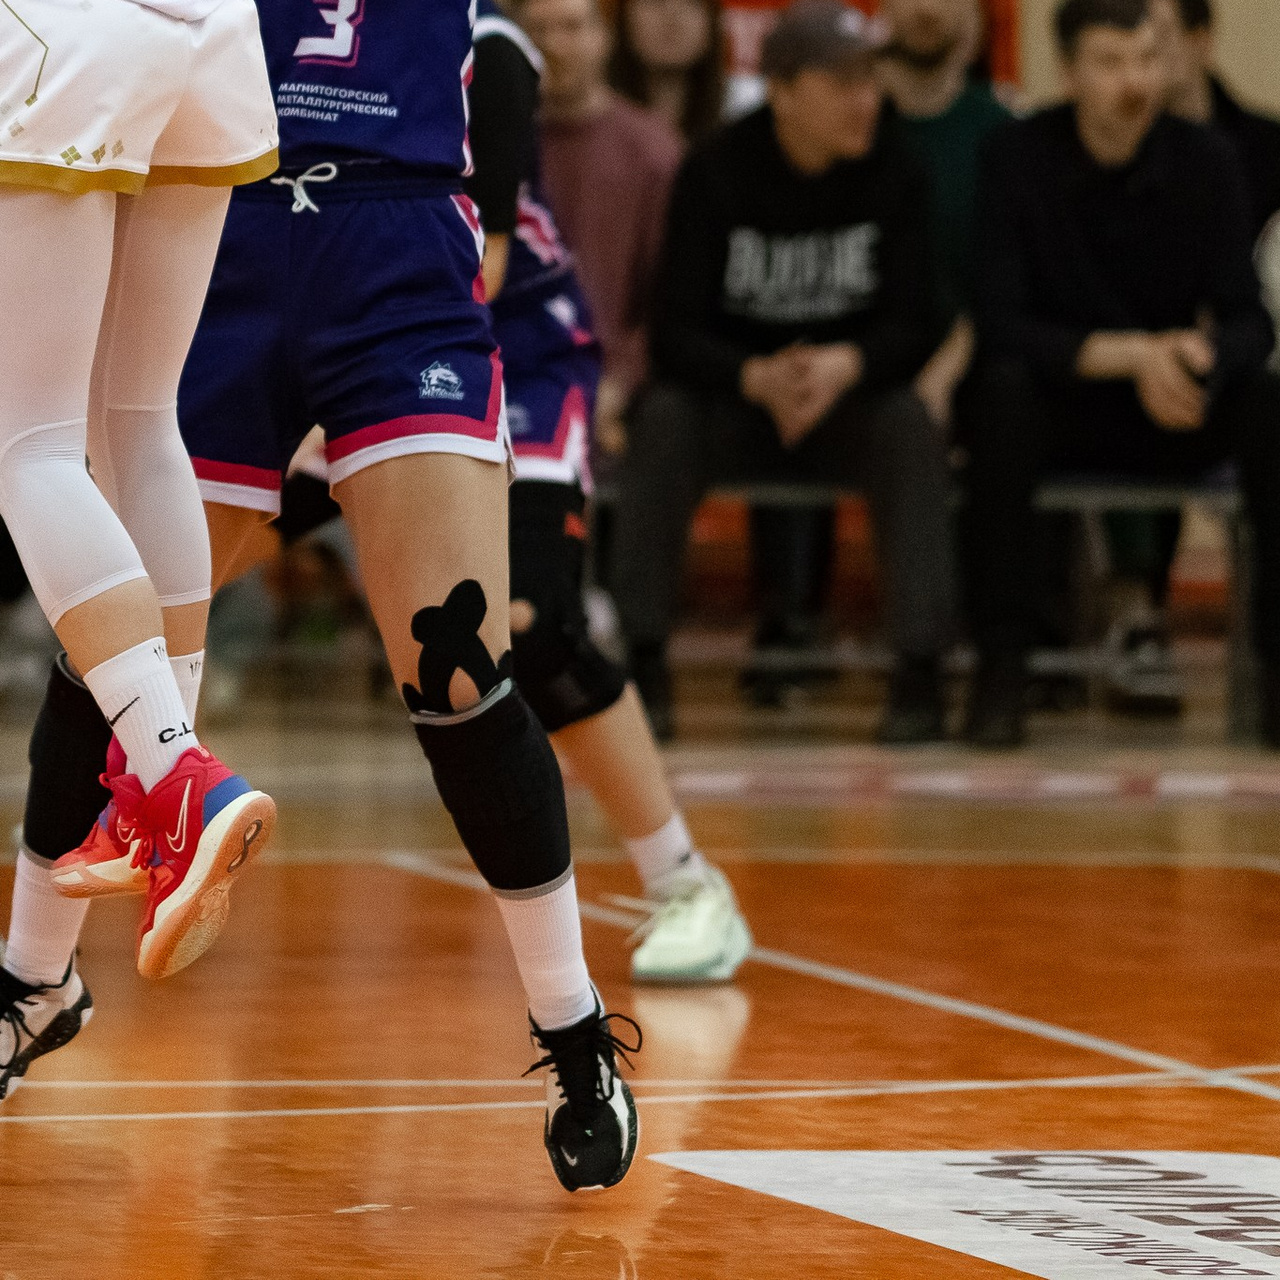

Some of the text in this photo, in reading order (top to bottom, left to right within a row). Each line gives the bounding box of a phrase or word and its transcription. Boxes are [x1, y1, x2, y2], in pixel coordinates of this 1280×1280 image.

[279, 83, 388, 103] МАГНИТОГОРСКИЙ
[277, 94, 398, 117] МЕТАЛЛУРГИЧЕСКИЙ
[277, 107, 339, 121] КОМБИНАТ
[942, 1154, 1280, 1257] ЕКИСЬ
[951, 1210, 1274, 1276] ВОЛЖСКАЯ
